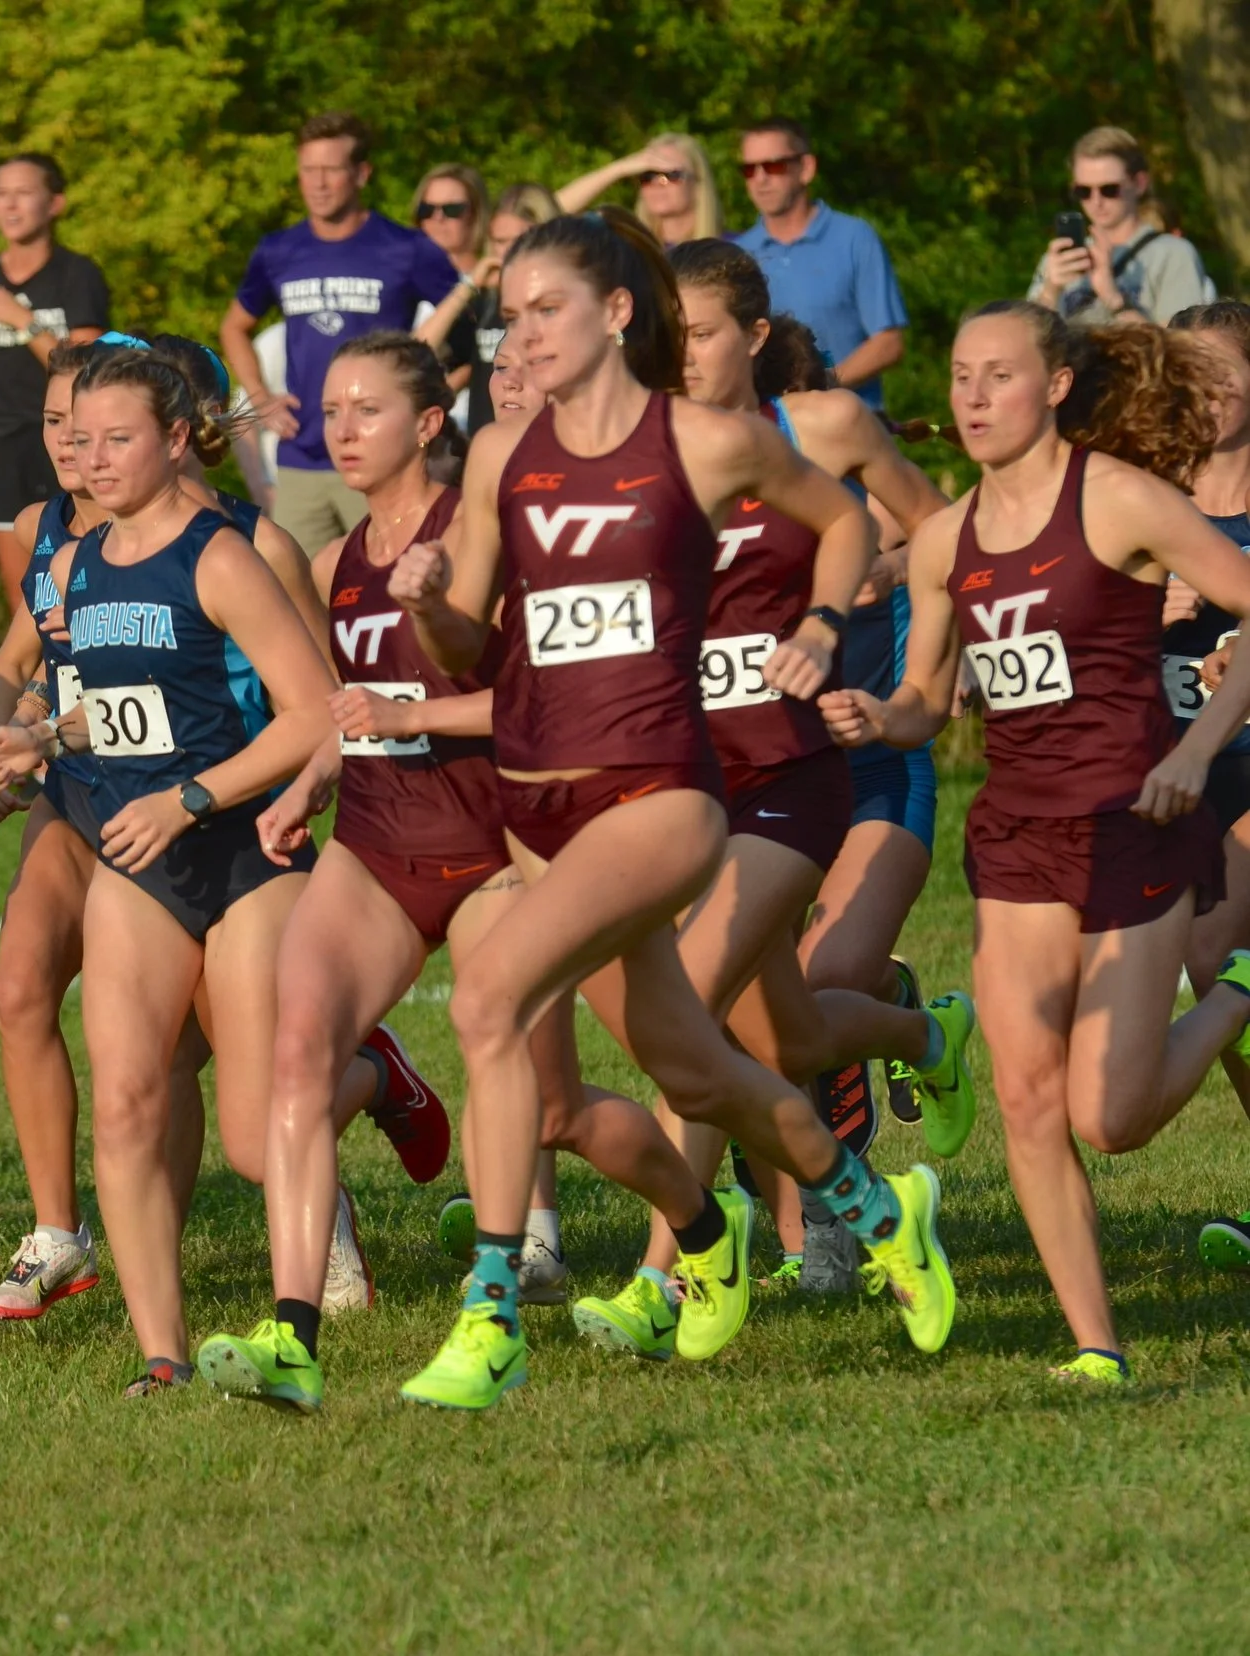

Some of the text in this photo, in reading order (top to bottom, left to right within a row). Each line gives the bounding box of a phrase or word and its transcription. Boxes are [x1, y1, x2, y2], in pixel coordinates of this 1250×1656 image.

[524, 504, 638, 557] VT
[70, 602, 178, 655] AUGUSTA
[333, 611, 403, 666] VT
[533, 591, 645, 653] 294
[969, 588, 1050, 640] VT
[701, 644, 769, 700] 95
[974, 642, 1063, 699] 292
[95, 696, 149, 746] 30
